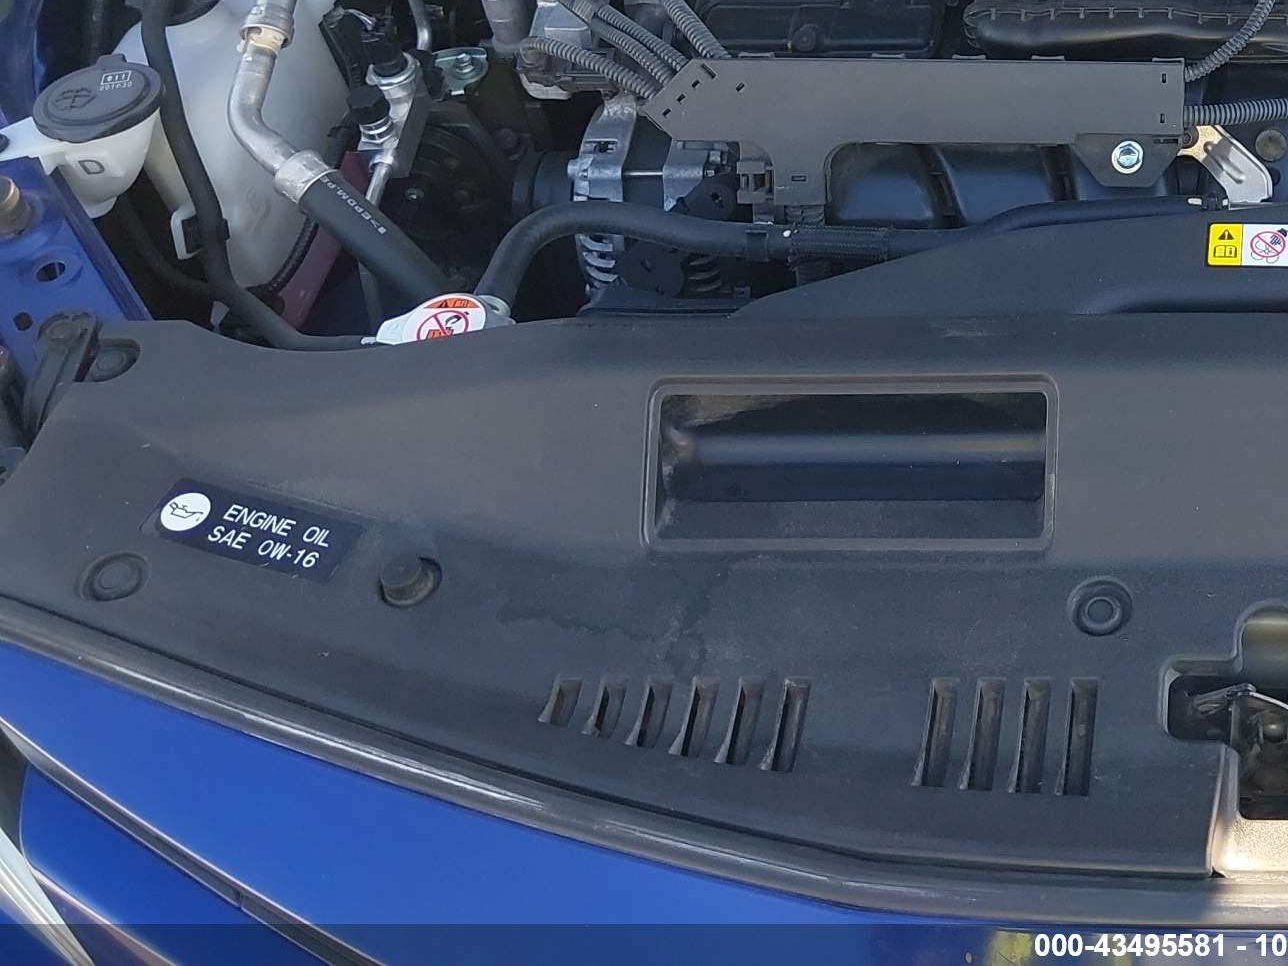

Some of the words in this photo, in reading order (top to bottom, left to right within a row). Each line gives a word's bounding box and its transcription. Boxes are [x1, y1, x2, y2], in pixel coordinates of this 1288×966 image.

[78, 159, 105, 176] D
[207, 525, 251, 549] SAE
[258, 540, 320, 568] 0W-16
[223, 504, 297, 537] ENGINE
[302, 526, 330, 547] OIL
